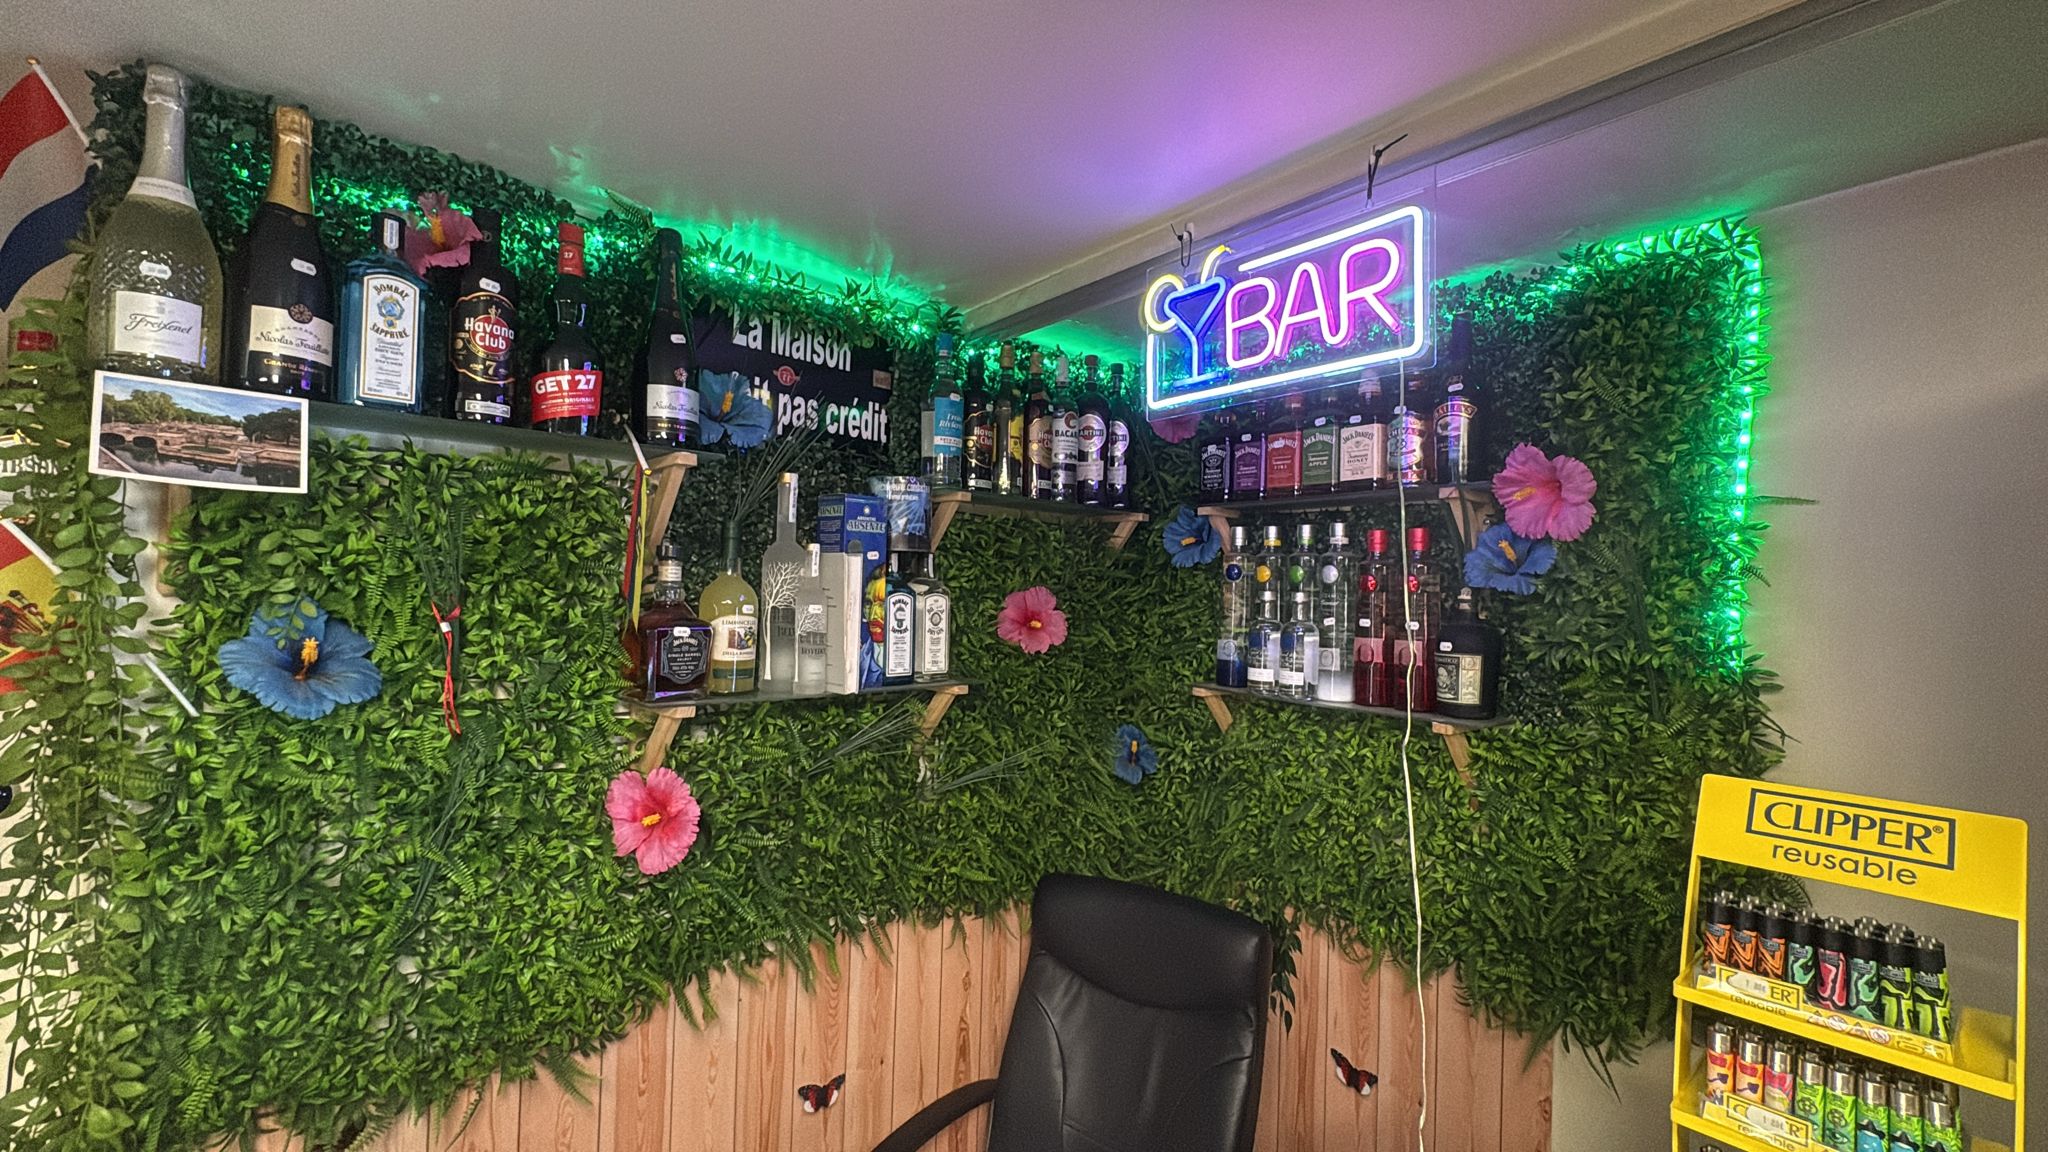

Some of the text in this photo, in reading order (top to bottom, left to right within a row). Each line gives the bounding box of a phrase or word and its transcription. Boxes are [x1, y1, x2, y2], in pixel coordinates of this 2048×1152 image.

[373, 283, 409, 301] BOMBAY
[1226, 238, 1400, 368] BAR
[125, 313, 193, 335] Freixenet
[370, 322, 409, 339] SAPPHIRE
[464, 317, 515, 340] Havana
[256, 331, 294, 345] Nicolas
[475, 333, 507, 349] Club
[732, 303, 852, 372] La Maison
[486, 361, 497, 375] 7
[535, 374, 596, 394] GET 27
[777, 392, 819, 435] pas
[825, 396, 888, 444] crédit
[1771, 842, 1918, 885] reusable
